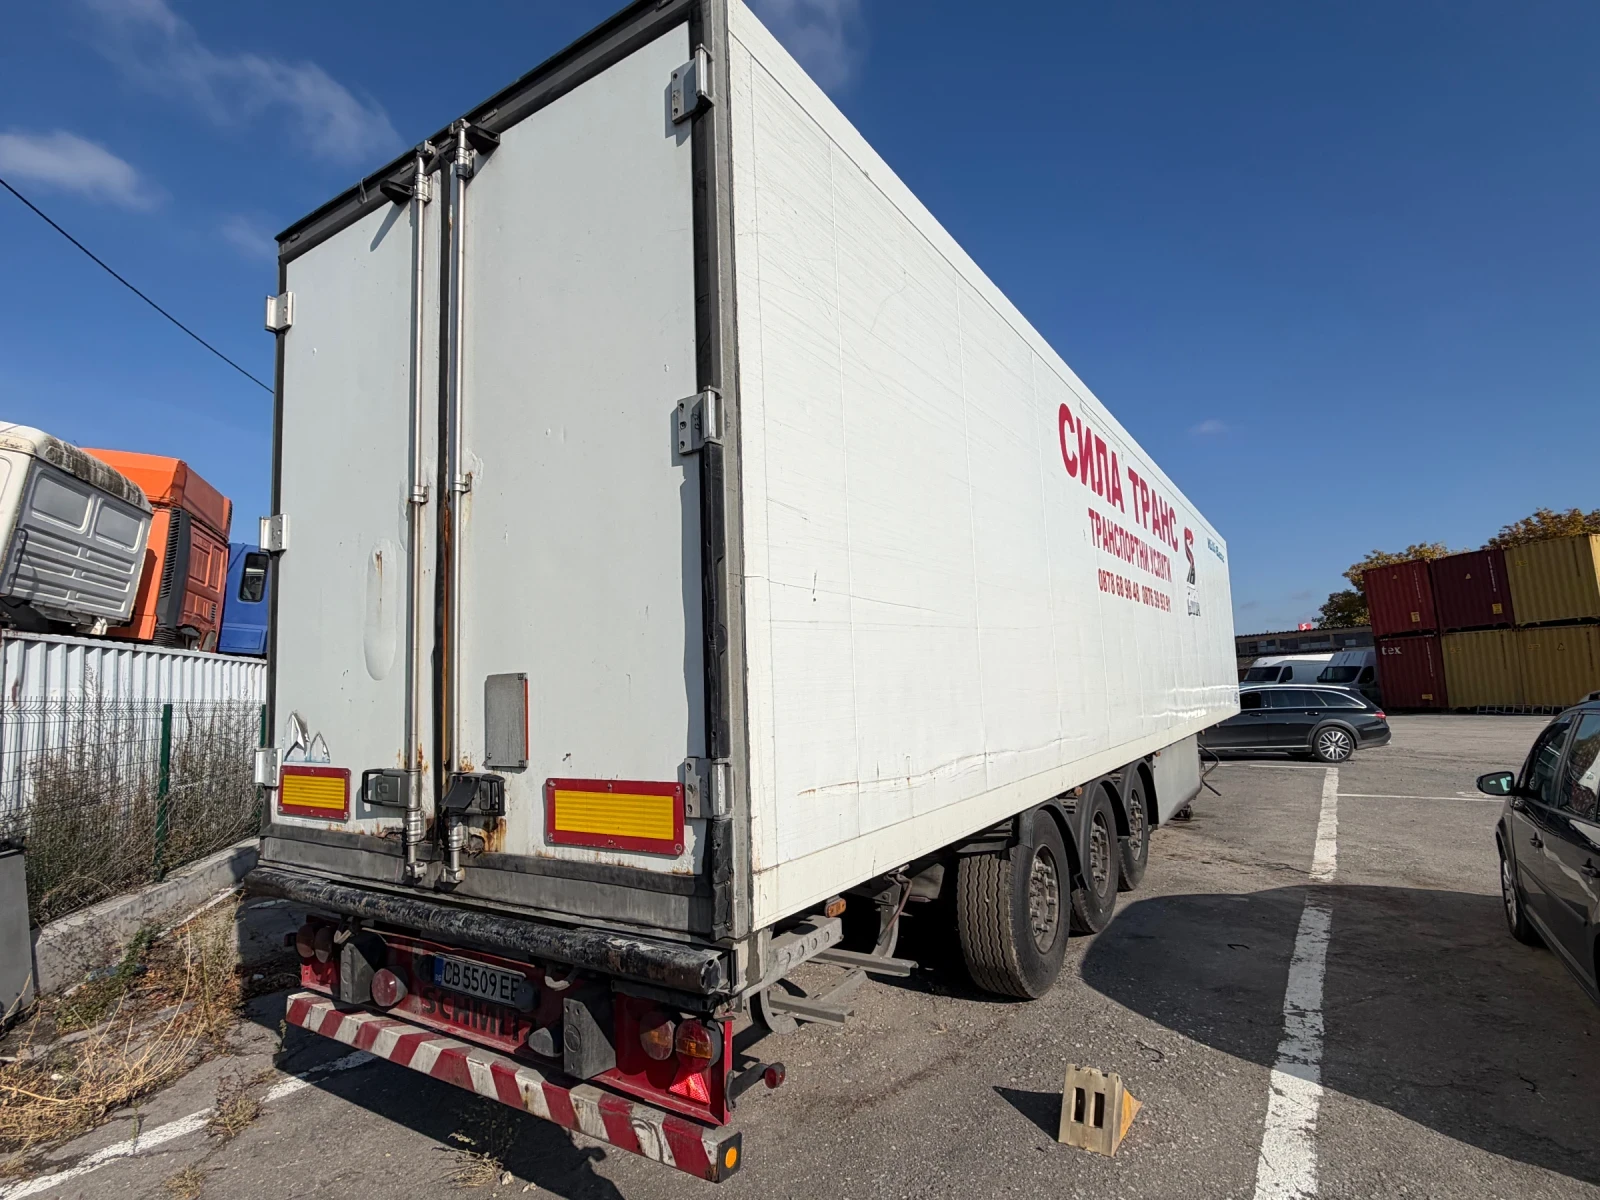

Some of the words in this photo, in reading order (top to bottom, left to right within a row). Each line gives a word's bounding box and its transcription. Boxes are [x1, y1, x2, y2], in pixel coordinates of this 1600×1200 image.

[1058, 403, 1125, 514] СИЛА
[1127, 466, 1179, 552] ТРАНС
[1088, 507, 1150, 574] ТРАНСПОРТНИ
[1381, 646, 1402, 656] tex
[462, 966, 497, 997] 5509
